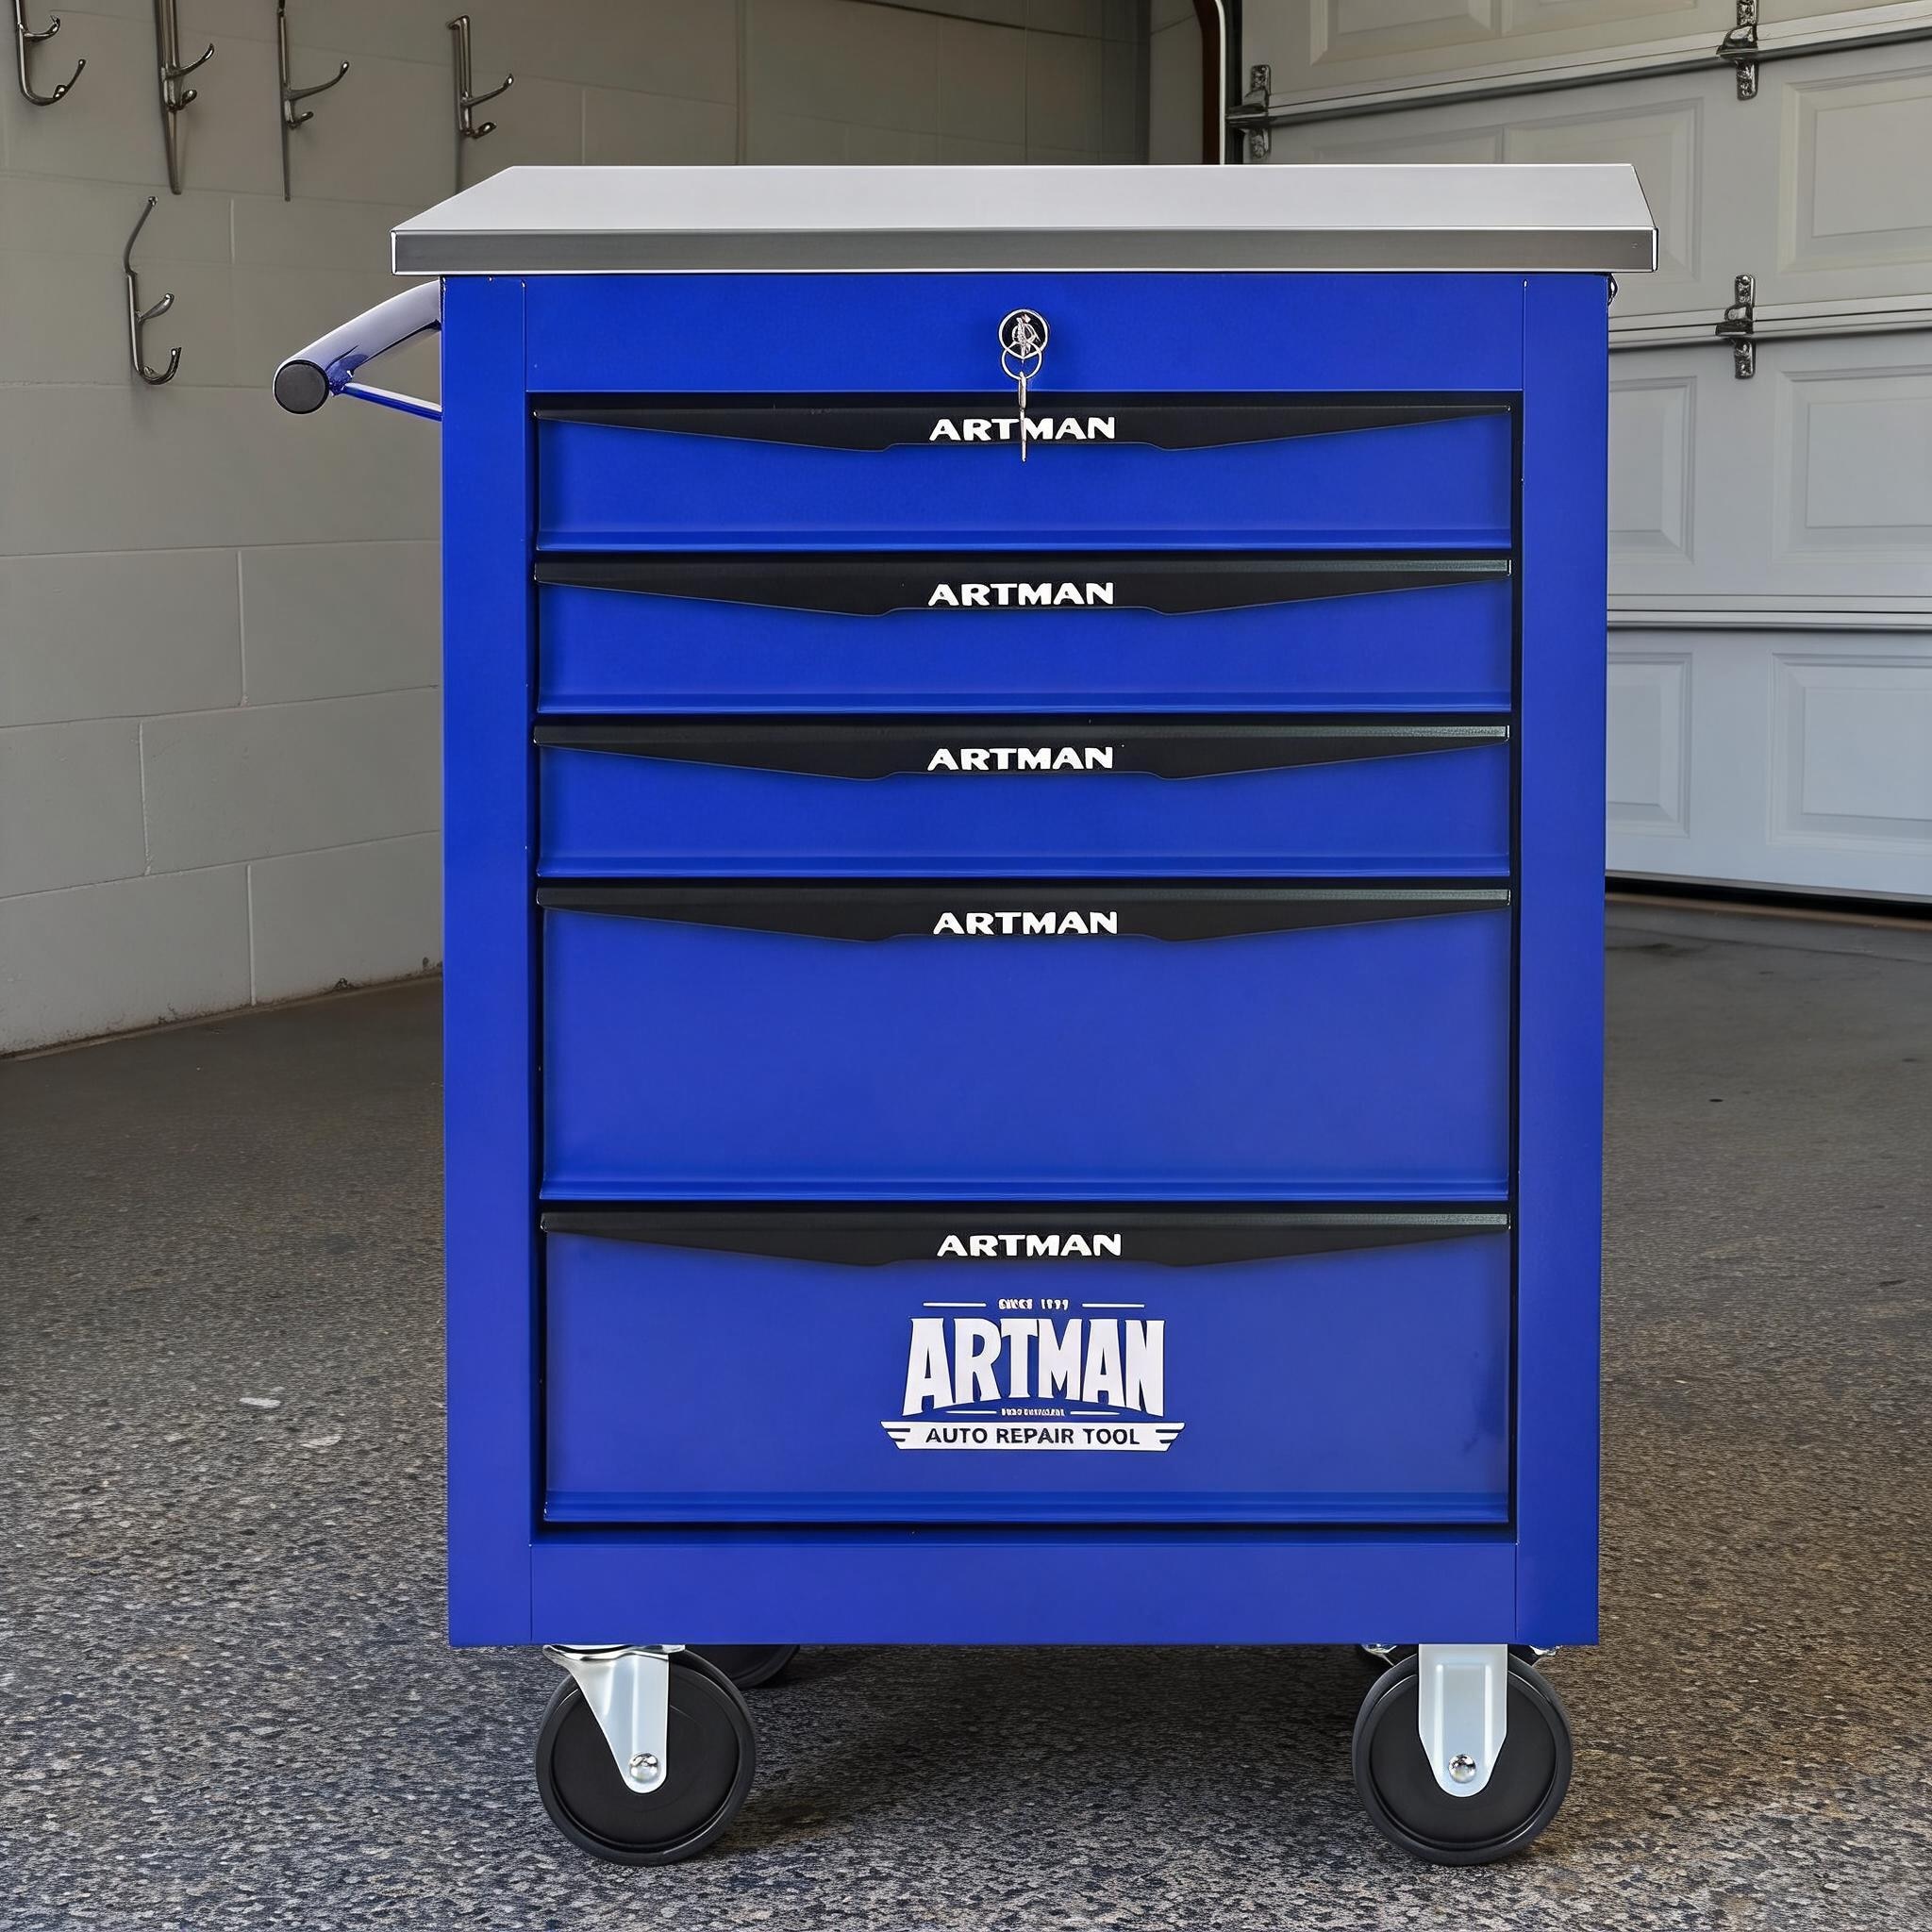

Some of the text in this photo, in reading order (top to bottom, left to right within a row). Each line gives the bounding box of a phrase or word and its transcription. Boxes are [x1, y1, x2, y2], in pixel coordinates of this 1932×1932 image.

[929, 416, 1115, 441] ARTMAN
[928, 582, 1114, 607] ARTMAN
[927, 746, 1113, 772] ARTMAN
[933, 911, 1118, 935] ARTMAN
[937, 1233, 1122, 1257] ARTMAN
[902, 1317, 1165, 1417] ARTMAN
[925, 1427, 1141, 1445] AUTO REPAIR TOOL
